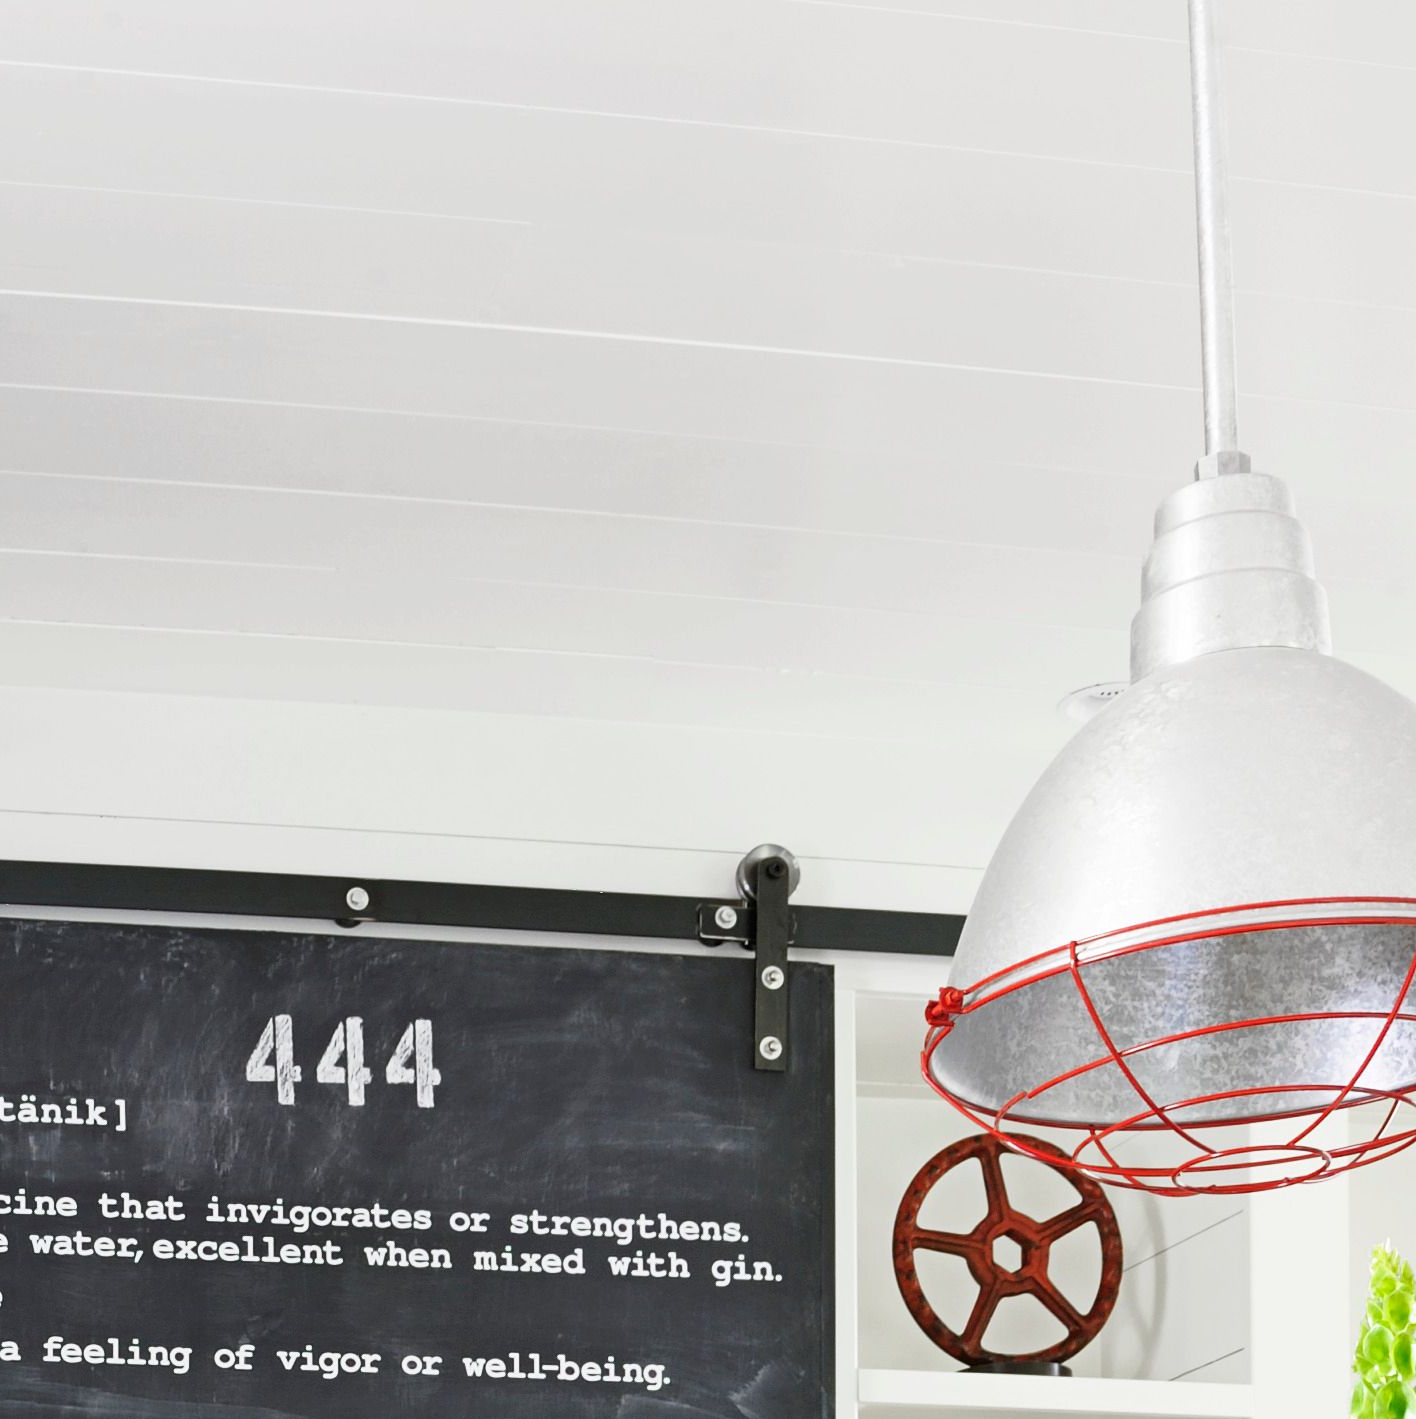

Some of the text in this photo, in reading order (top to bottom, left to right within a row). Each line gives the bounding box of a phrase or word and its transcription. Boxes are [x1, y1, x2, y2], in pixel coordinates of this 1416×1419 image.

[246, 1014, 442, 1109] 444
[98, 1192, 186, 1221] that
[206, 1195, 432, 1233] invigorates
[449, 1210, 491, 1233] or
[510, 1209, 749, 1246] strengthens.
[153, 1236, 345, 1267] excellent
[364, 1241, 452, 1269] when
[473, 1245, 585, 1275] mixed
[607, 1251, 691, 1278] with
[711, 1253, 783, 1287] gin.
[0, 1340, 21, 1362] a
[42, 1336, 193, 1374] feeling
[214, 1344, 255, 1371] of
[277, 1344, 382, 1380] vigor
[401, 1355, 443, 1376] or
[462, 1352, 671, 1391] well-being.
